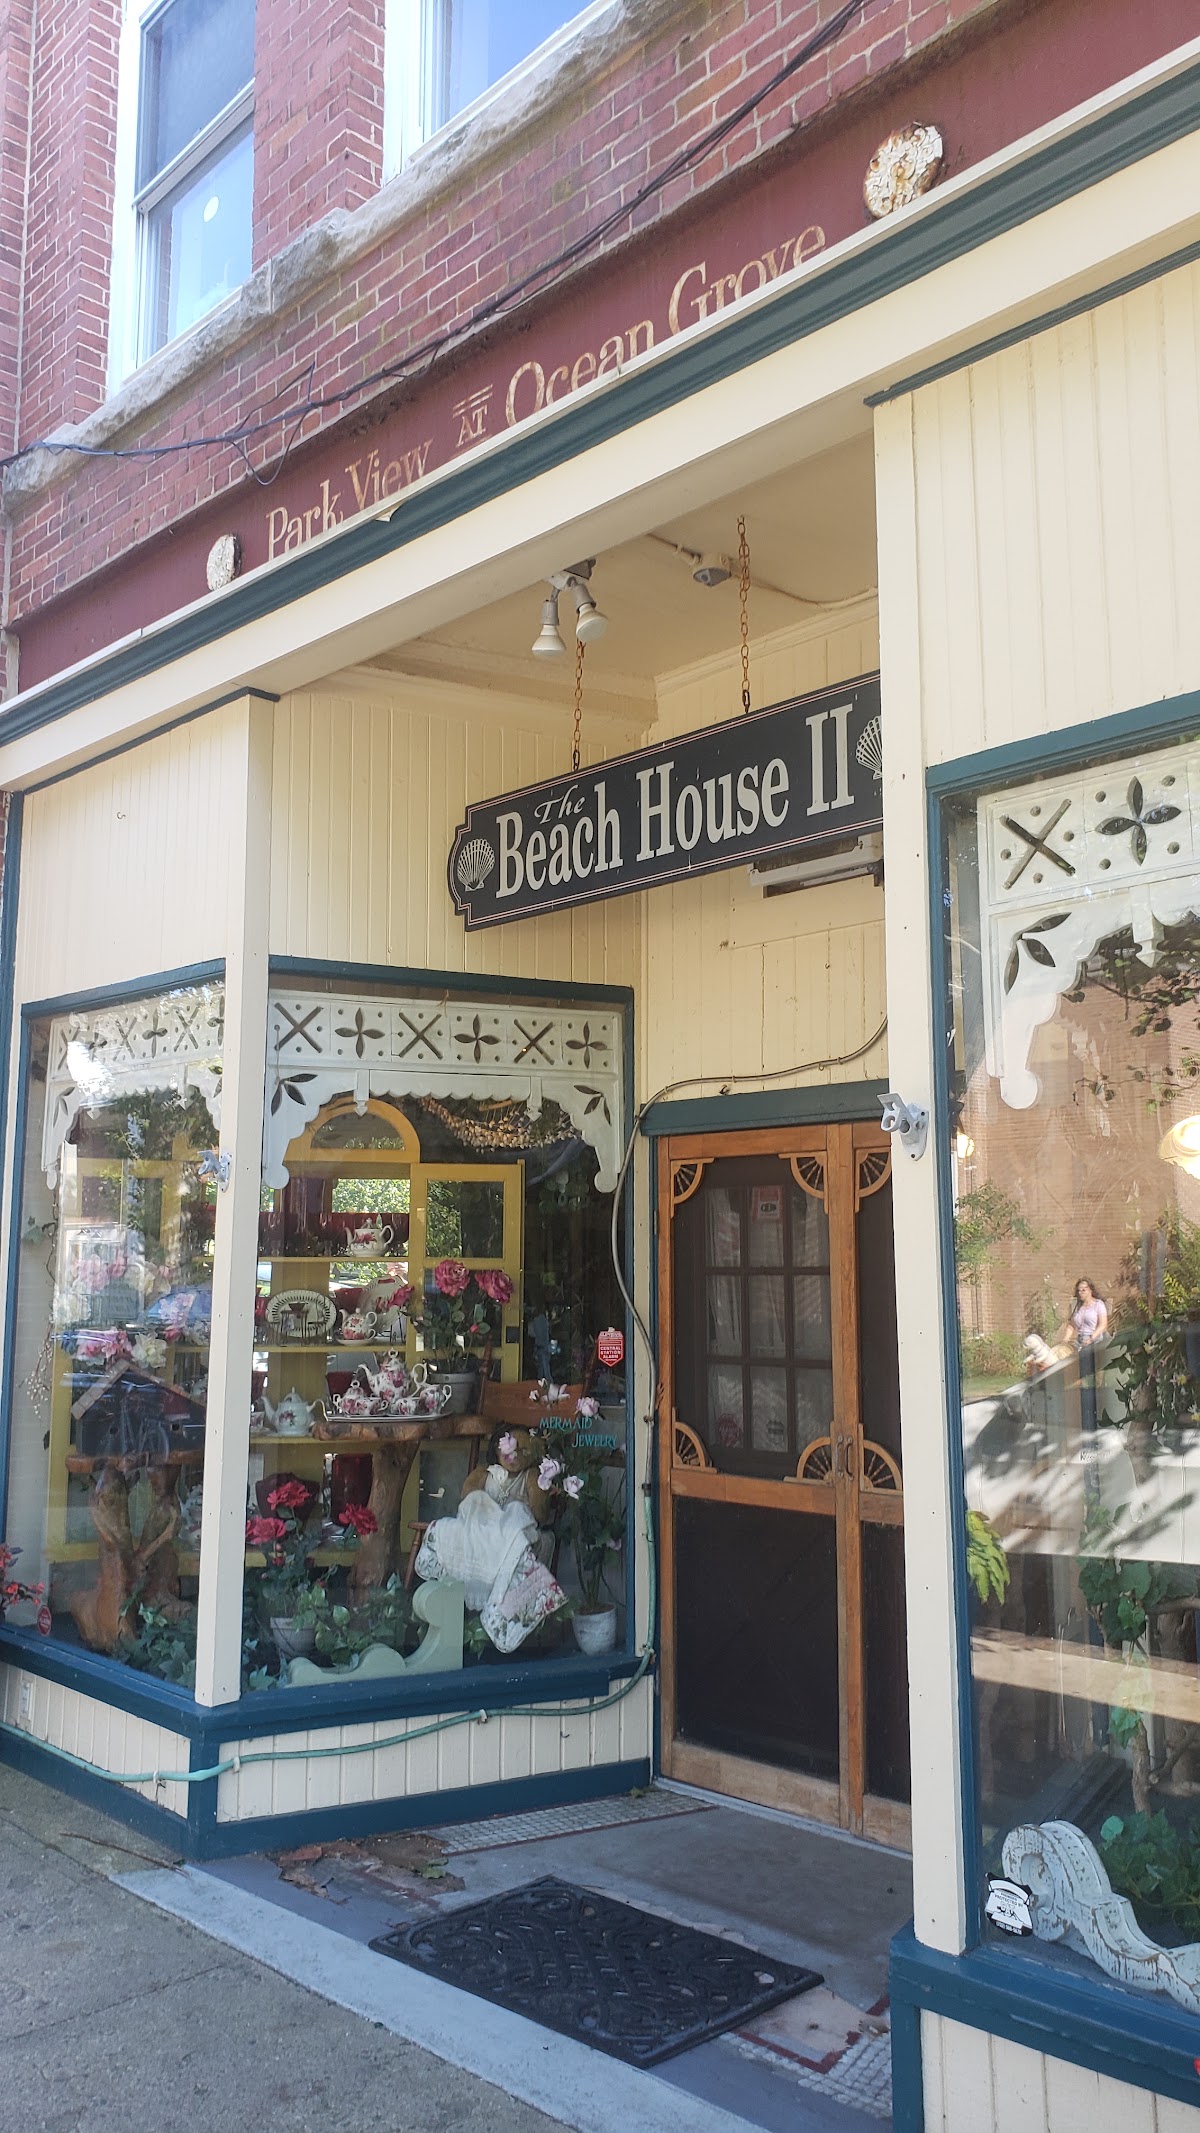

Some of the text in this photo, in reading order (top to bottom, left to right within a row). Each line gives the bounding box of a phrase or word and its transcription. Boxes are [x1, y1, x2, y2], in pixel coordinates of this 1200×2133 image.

[266, 225, 826, 561] Park View AT Ocean Grove
[495, 704, 855, 898] Beach House II
[534, 784, 586, 825] The
[540, 1416, 593, 1431] MERMAID
[572, 1432, 617, 1449] JEWELRY
